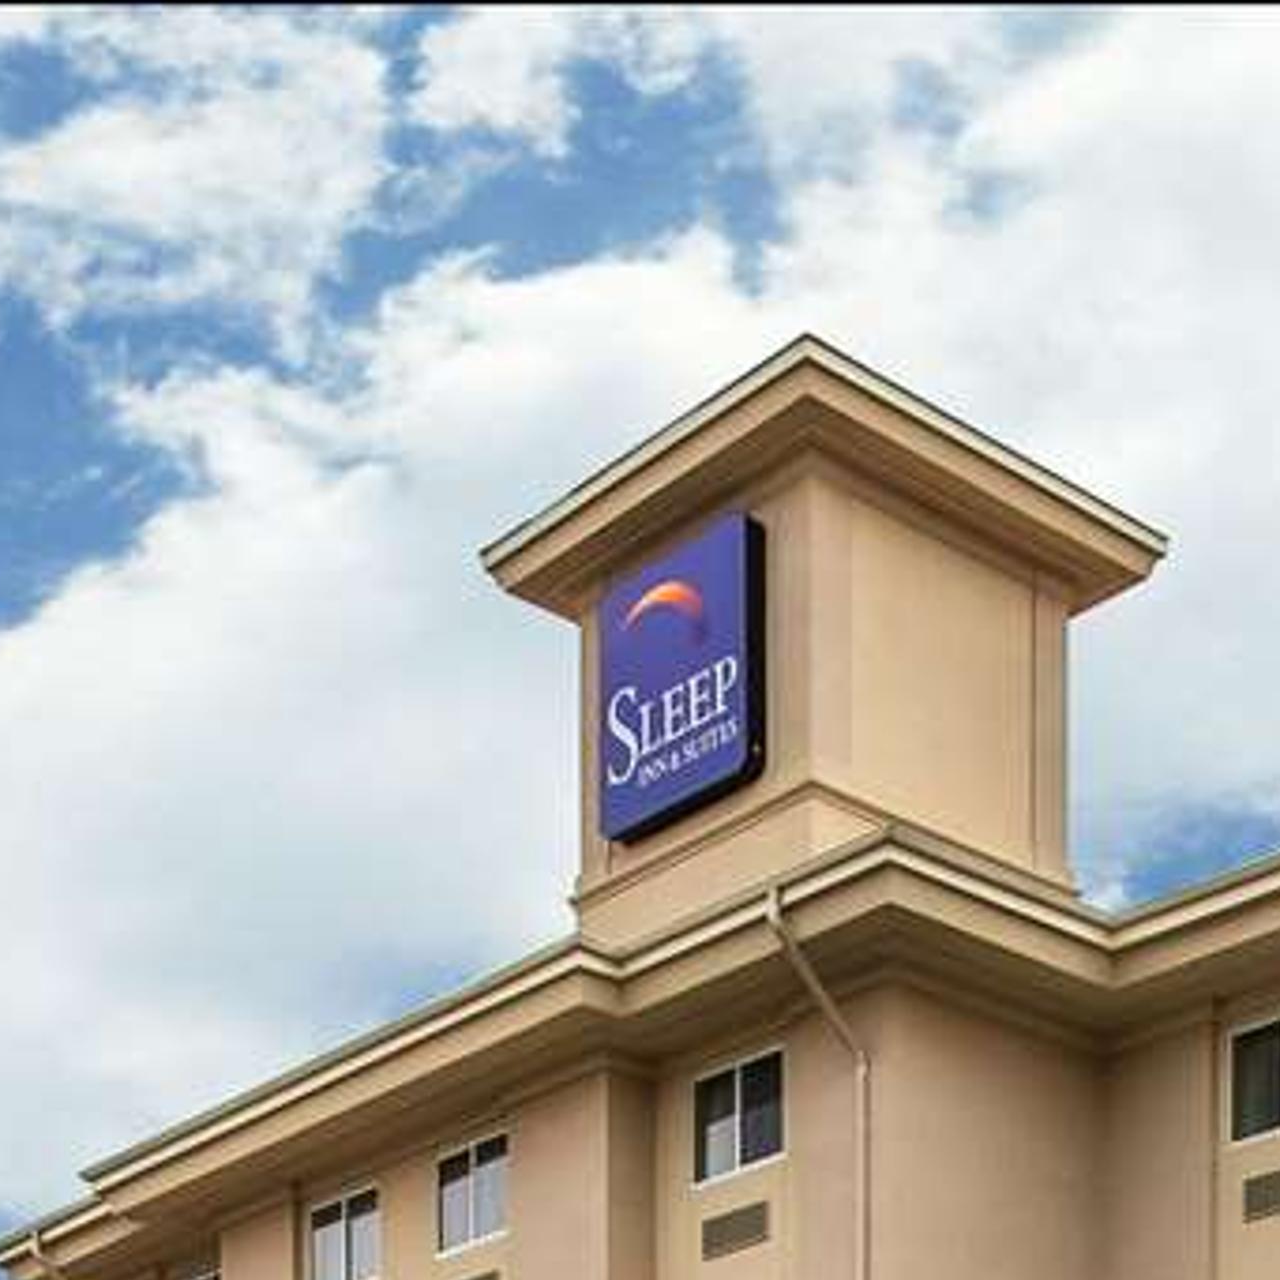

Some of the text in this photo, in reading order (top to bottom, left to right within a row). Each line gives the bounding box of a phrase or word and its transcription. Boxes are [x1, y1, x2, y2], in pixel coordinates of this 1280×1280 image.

[607, 656, 738, 785] SLEEP
[637, 757, 666, 787] INN
[682, 716, 738, 762] SUITES
